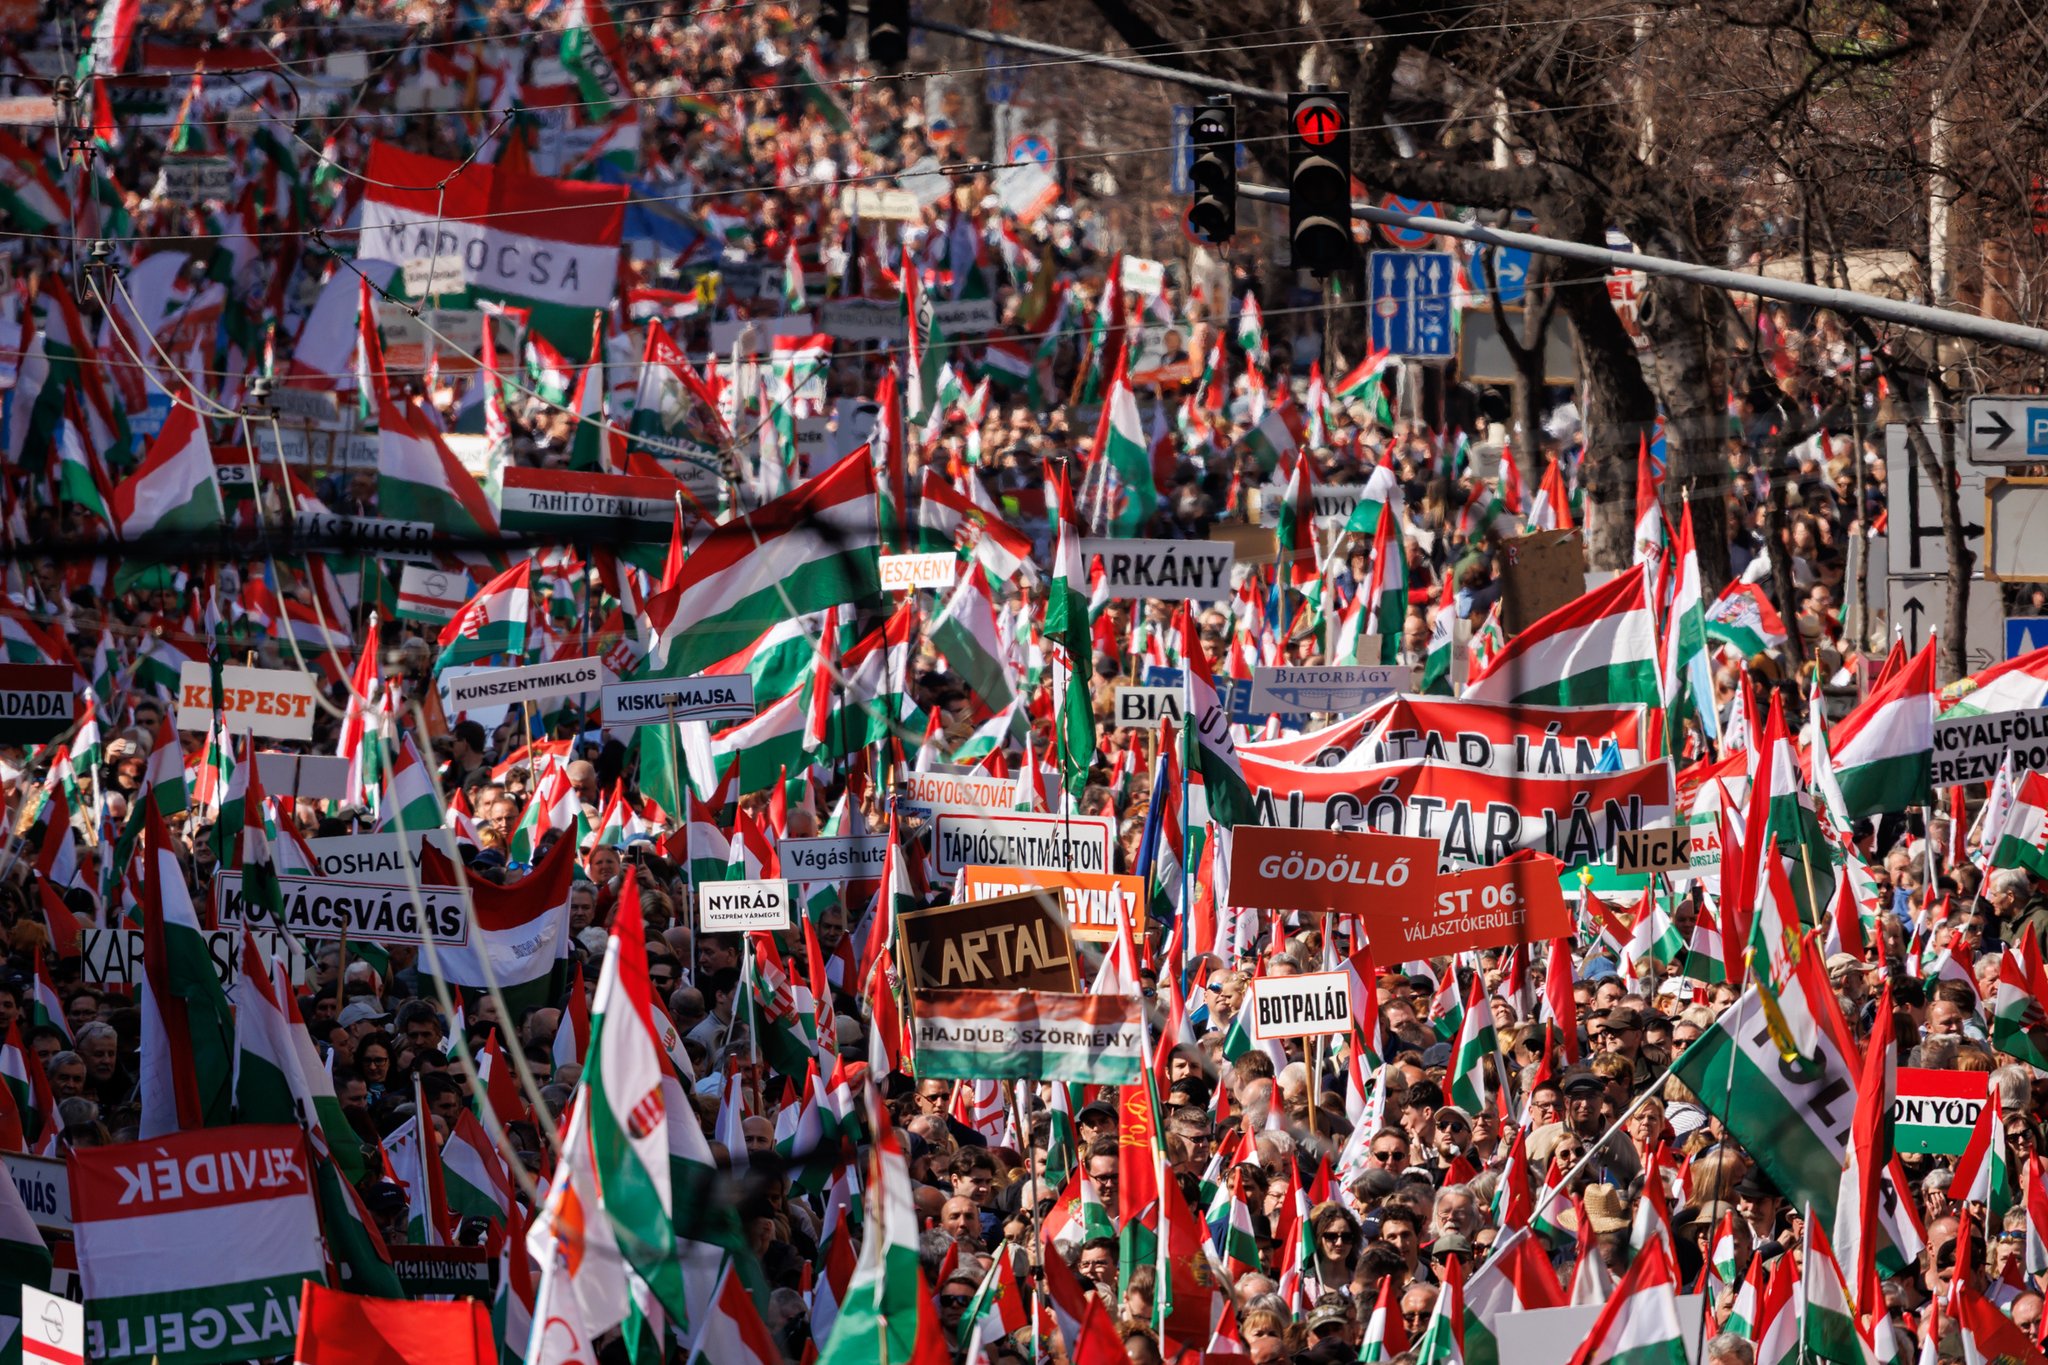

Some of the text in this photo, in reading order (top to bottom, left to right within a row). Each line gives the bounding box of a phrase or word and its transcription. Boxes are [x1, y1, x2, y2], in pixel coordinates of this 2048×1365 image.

[1081, 547, 1228, 588] RKÁNY
[456, 668, 597, 700] KUNSZENTMIKLÓS
[1275, 667, 1391, 684] BIATORBÁGY
[1121, 693, 1182, 721] BIA
[791, 848, 887, 870] Vágáshuta
[943, 827, 1102, 870] TÁPIÓSZENTMÁRTON
[1618, 830, 1691, 869] Nick
[1259, 850, 1411, 887] GÖDÖLLŐ
[709, 890, 780, 911] NYIRÁD
[1481, 882, 1525, 910] 06.
[709, 910, 780, 920] VESZPRÉM VÁRMEGYE
[1404, 908, 1527, 942] VÁLASZTÓKERÜLET
[909, 919, 1069, 988] KARTAL
[1259, 985, 1349, 1026] BOTPALÁD
